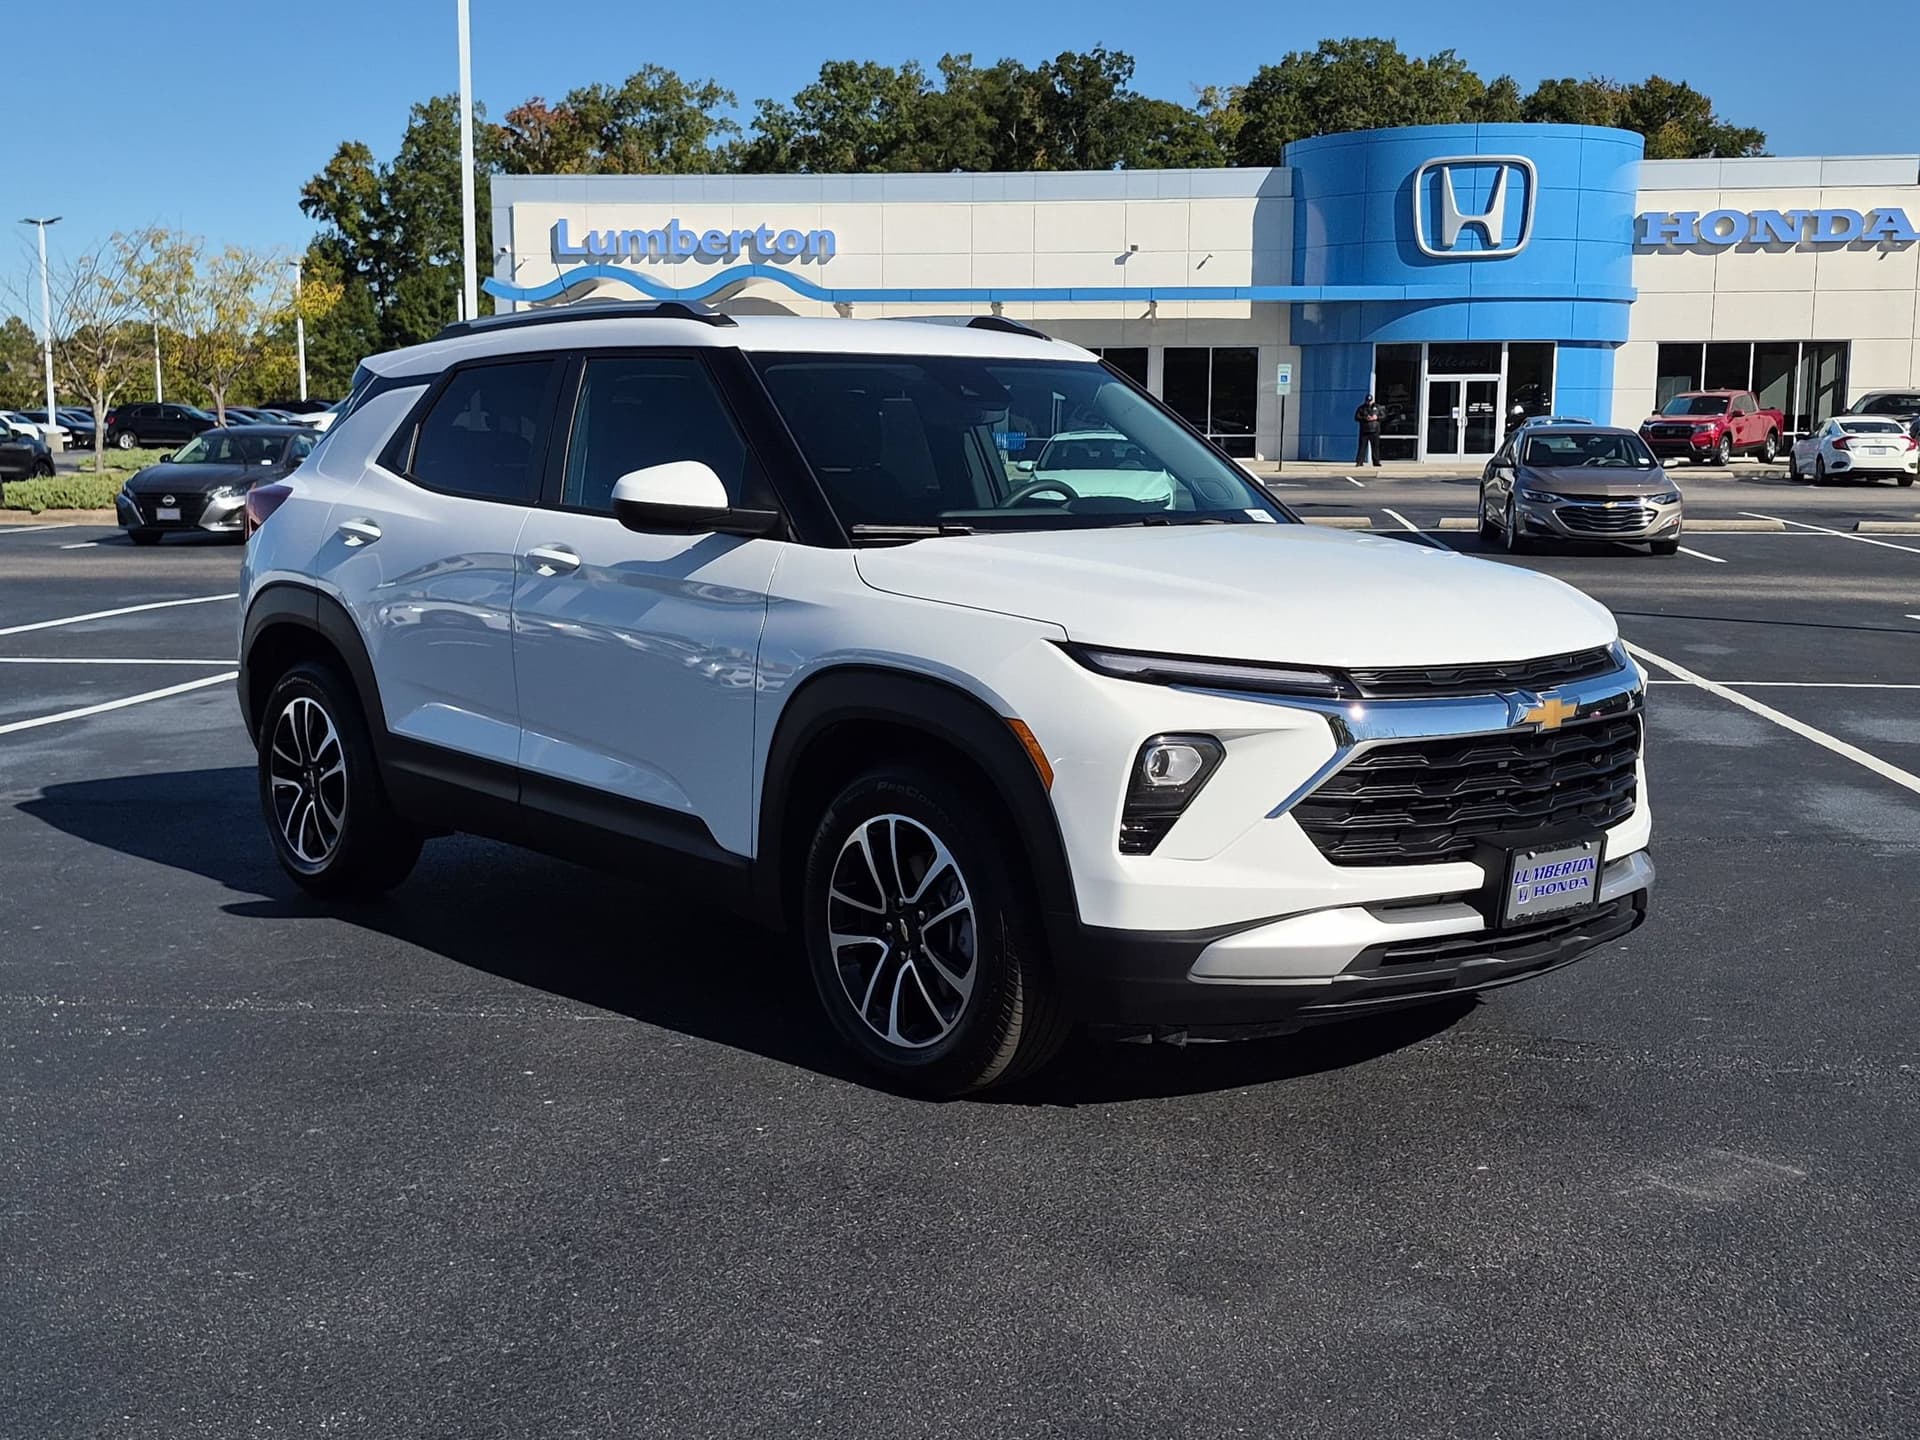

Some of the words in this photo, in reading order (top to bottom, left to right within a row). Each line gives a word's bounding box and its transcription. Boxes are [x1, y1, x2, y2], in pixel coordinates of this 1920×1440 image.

[556, 218, 836, 257] Lumberton
[1640, 207, 1920, 246] HONDA
[1533, 877, 1589, 897] HONDA
